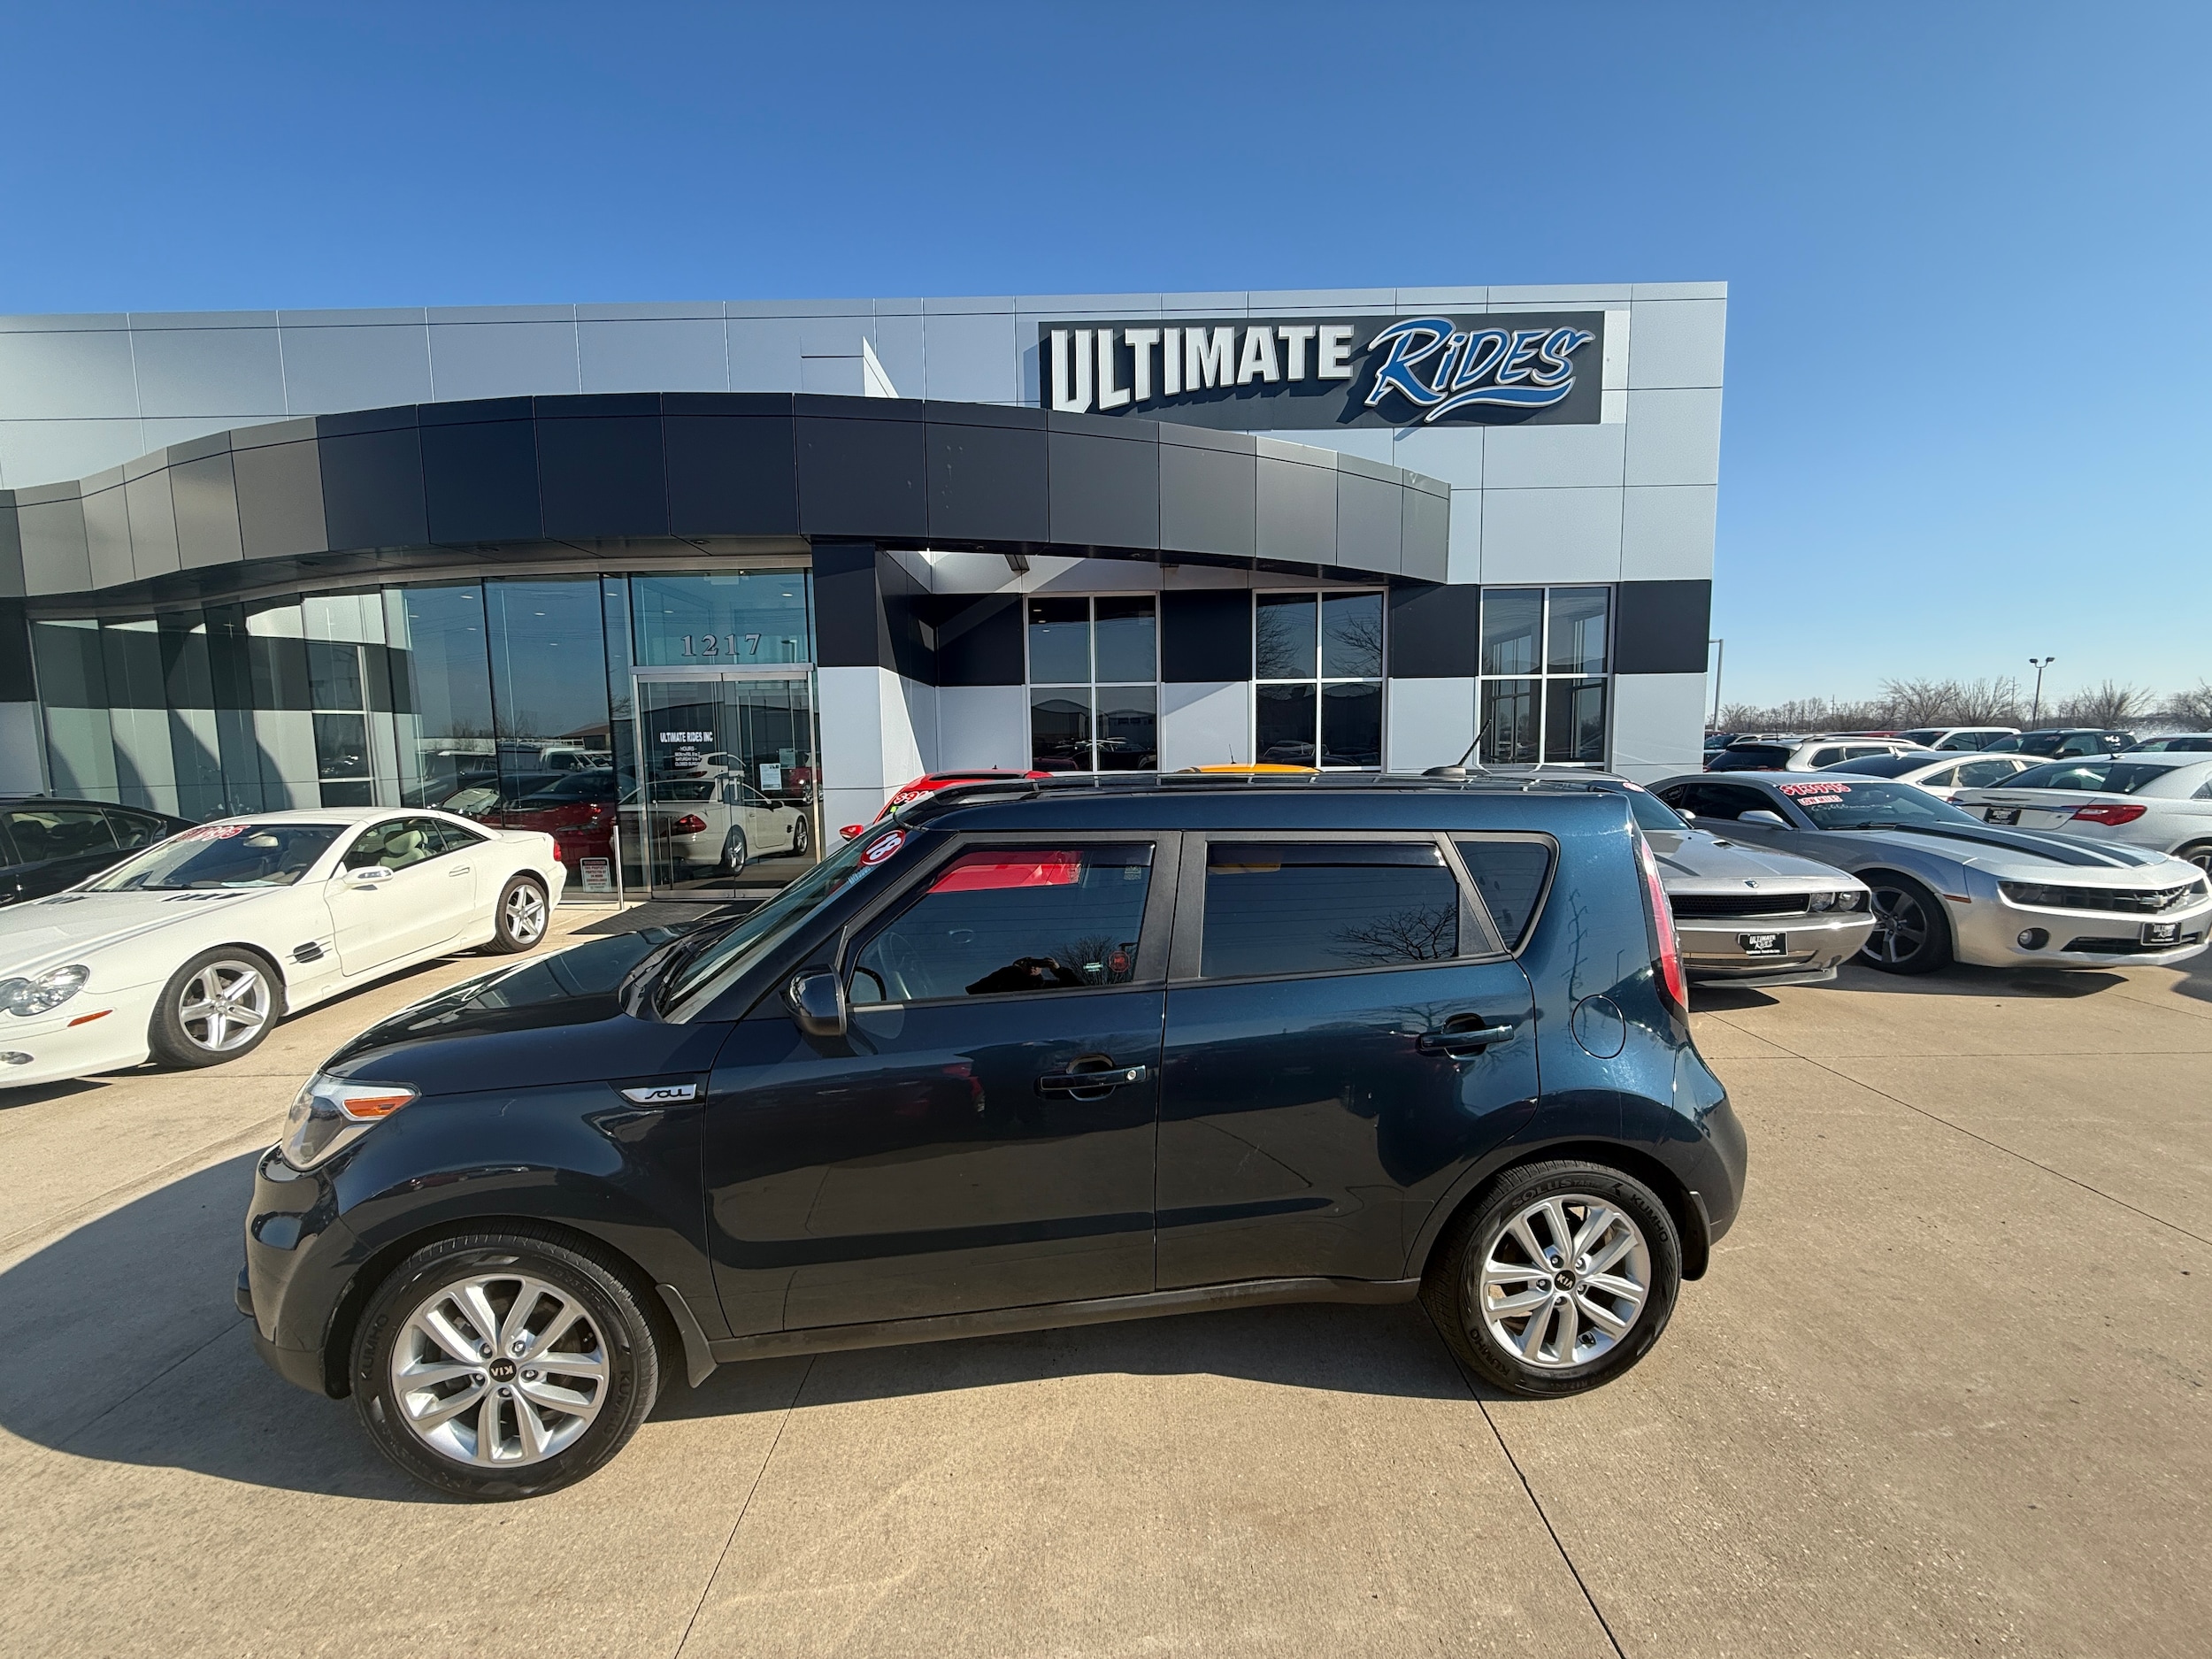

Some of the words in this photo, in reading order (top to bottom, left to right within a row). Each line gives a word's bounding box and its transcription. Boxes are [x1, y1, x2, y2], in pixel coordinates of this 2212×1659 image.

[1050, 324, 1355, 413] ULTIMATE
[681, 634, 761, 657] 1217
[659, 732, 686, 742] ULTIMATE
[687, 732, 703, 742] RIDES
[703, 732, 713, 742] INC
[866, 833, 902, 860] 18
[1749, 934, 1777, 945] ULTIMATE
[644, 1088, 691, 1099] SOUL
[1511, 1178, 1572, 1209] SOLUS
[1630, 1194, 1669, 1242] KUMHO
[1556, 1273, 1573, 1288] KIA
[361, 1313, 389, 1381] KUMHO
[1469, 1328, 1510, 1377] KUMHO
[490, 1364, 514, 1377] KIA
